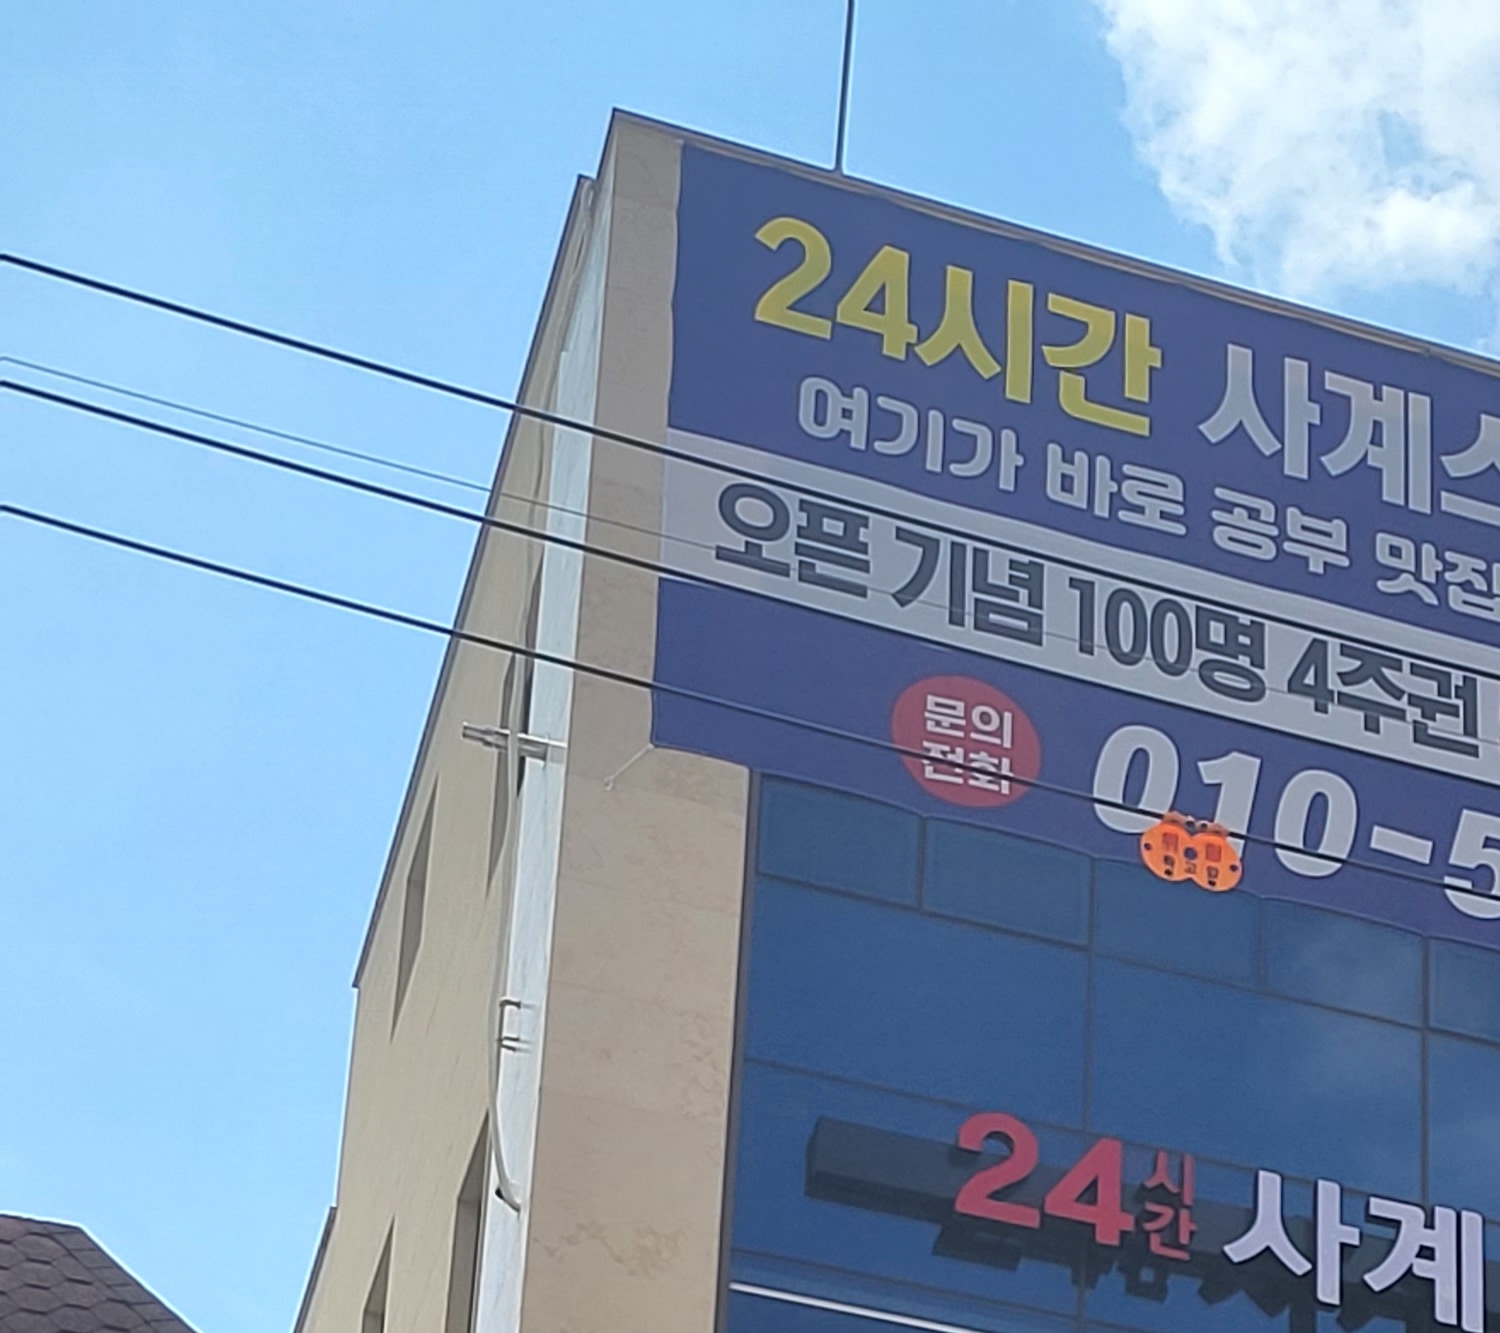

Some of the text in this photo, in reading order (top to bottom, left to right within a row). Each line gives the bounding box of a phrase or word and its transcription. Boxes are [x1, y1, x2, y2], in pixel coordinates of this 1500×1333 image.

[753, 216, 1163, 437] 24시간
[798, 376, 1025, 492] 여기가
[1046, 443, 1187, 536] 바로
[1210, 485, 1350, 575] 공부
[714, 482, 871, 600] 오픈
[890, 526, 1045, 647] 기념
[1069, 577, 1267, 704] 100명
[1287, 636, 1480, 758] 4주권
[922, 740, 1013, 795] 전화
[924, 694, 1012, 748] 문의
